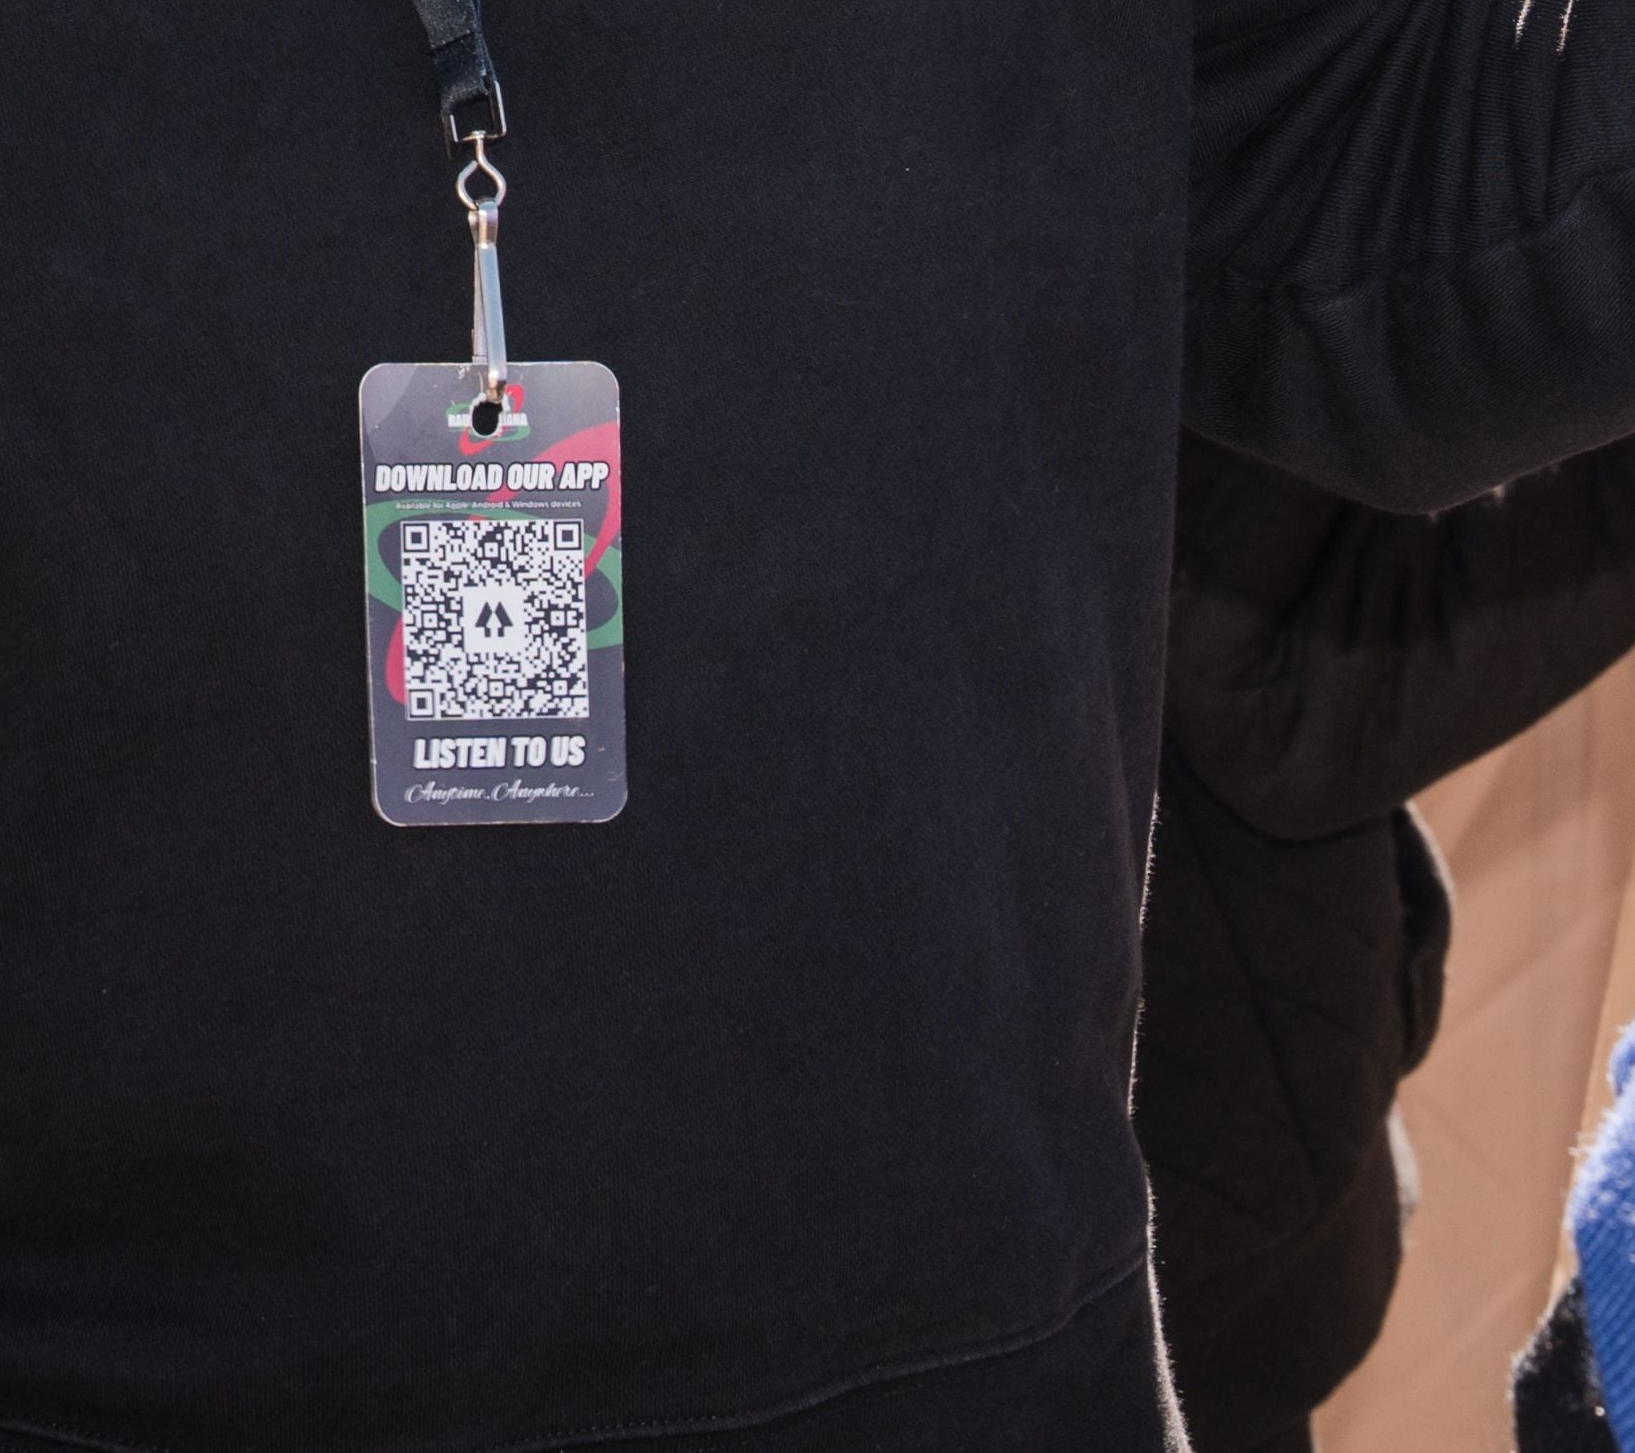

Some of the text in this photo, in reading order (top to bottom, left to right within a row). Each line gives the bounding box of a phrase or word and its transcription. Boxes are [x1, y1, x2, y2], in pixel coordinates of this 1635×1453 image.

[375, 461, 610, 493] DOWNLOAD OUR APP
[413, 735, 587, 769] LISTEN TO US
